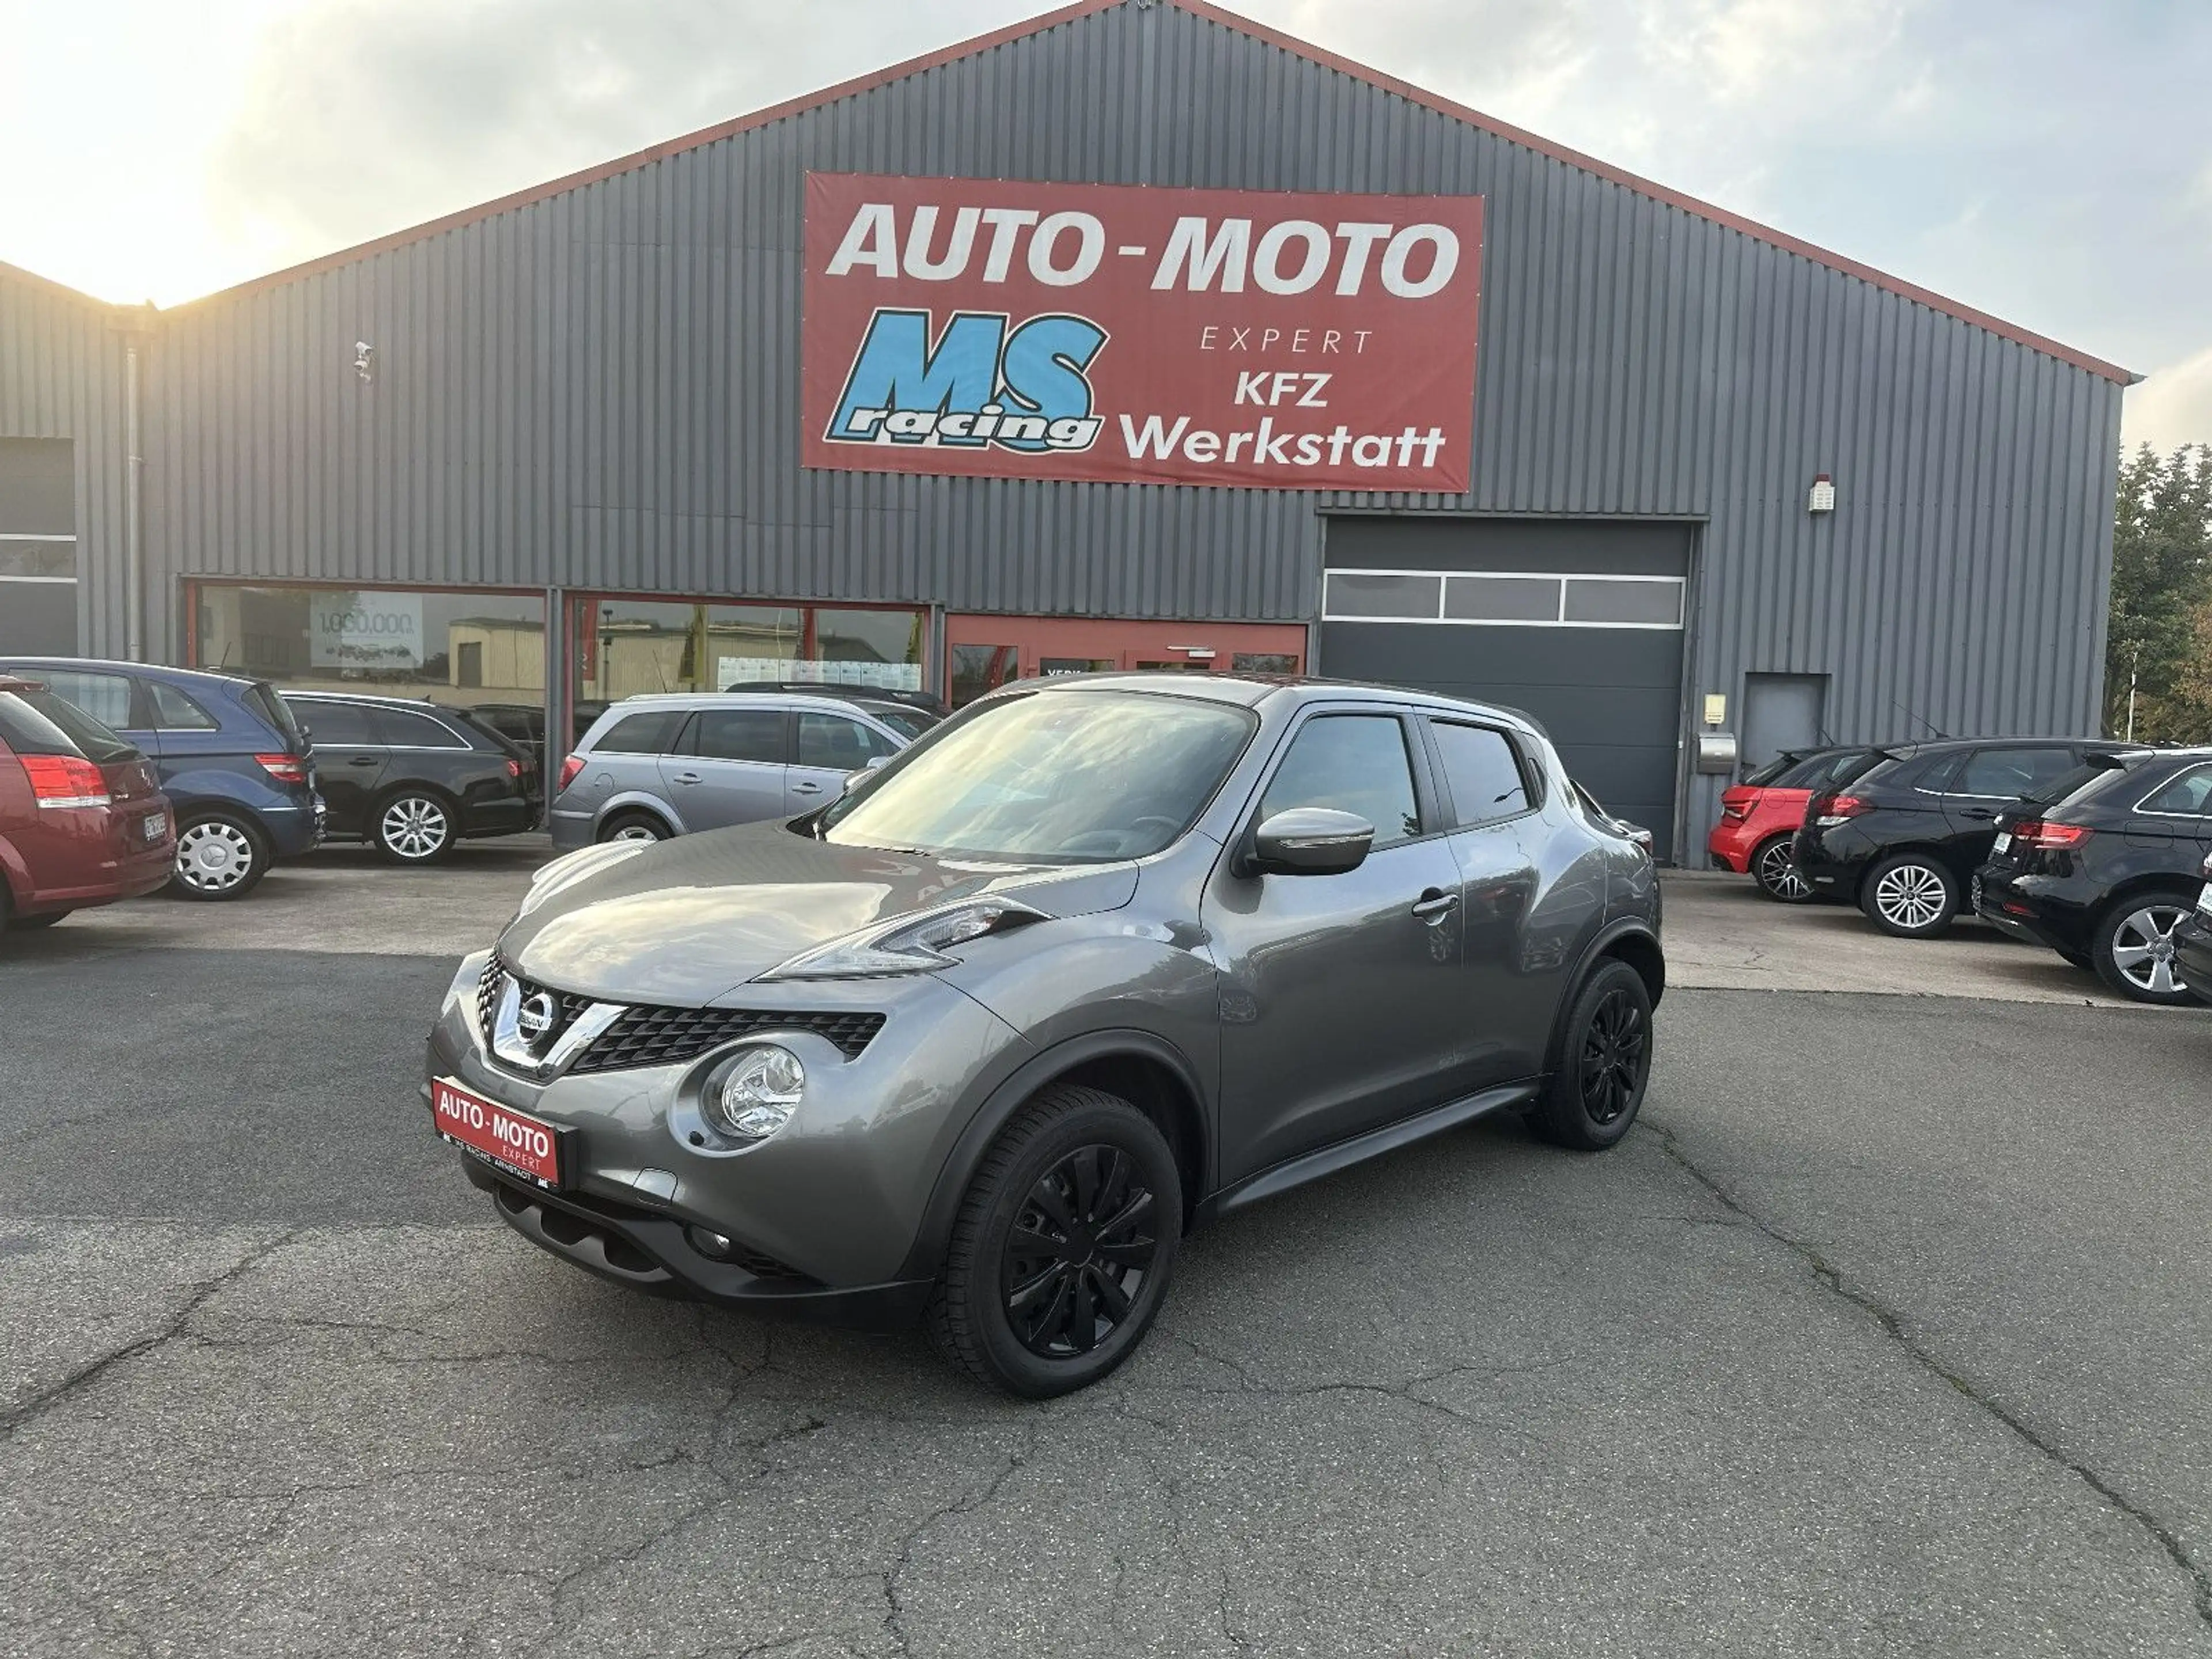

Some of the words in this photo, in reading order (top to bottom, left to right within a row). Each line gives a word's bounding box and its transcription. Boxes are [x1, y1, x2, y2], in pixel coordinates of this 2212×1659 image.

[825, 203, 1105, 286] AUTO
[1150, 217, 1460, 298] MOTO
[1200, 326, 1372, 354] EXPERT
[825, 309, 1109, 452] MS
[1234, 371, 1332, 408] KFZ
[845, 403, 1103, 449] racing
[1119, 414, 1446, 468] Werkstatt
[440, 1090, 483, 1130] AUTO
[493, 1113, 549, 1158] MOTO
[502, 1145, 541, 1170] EXPERT
